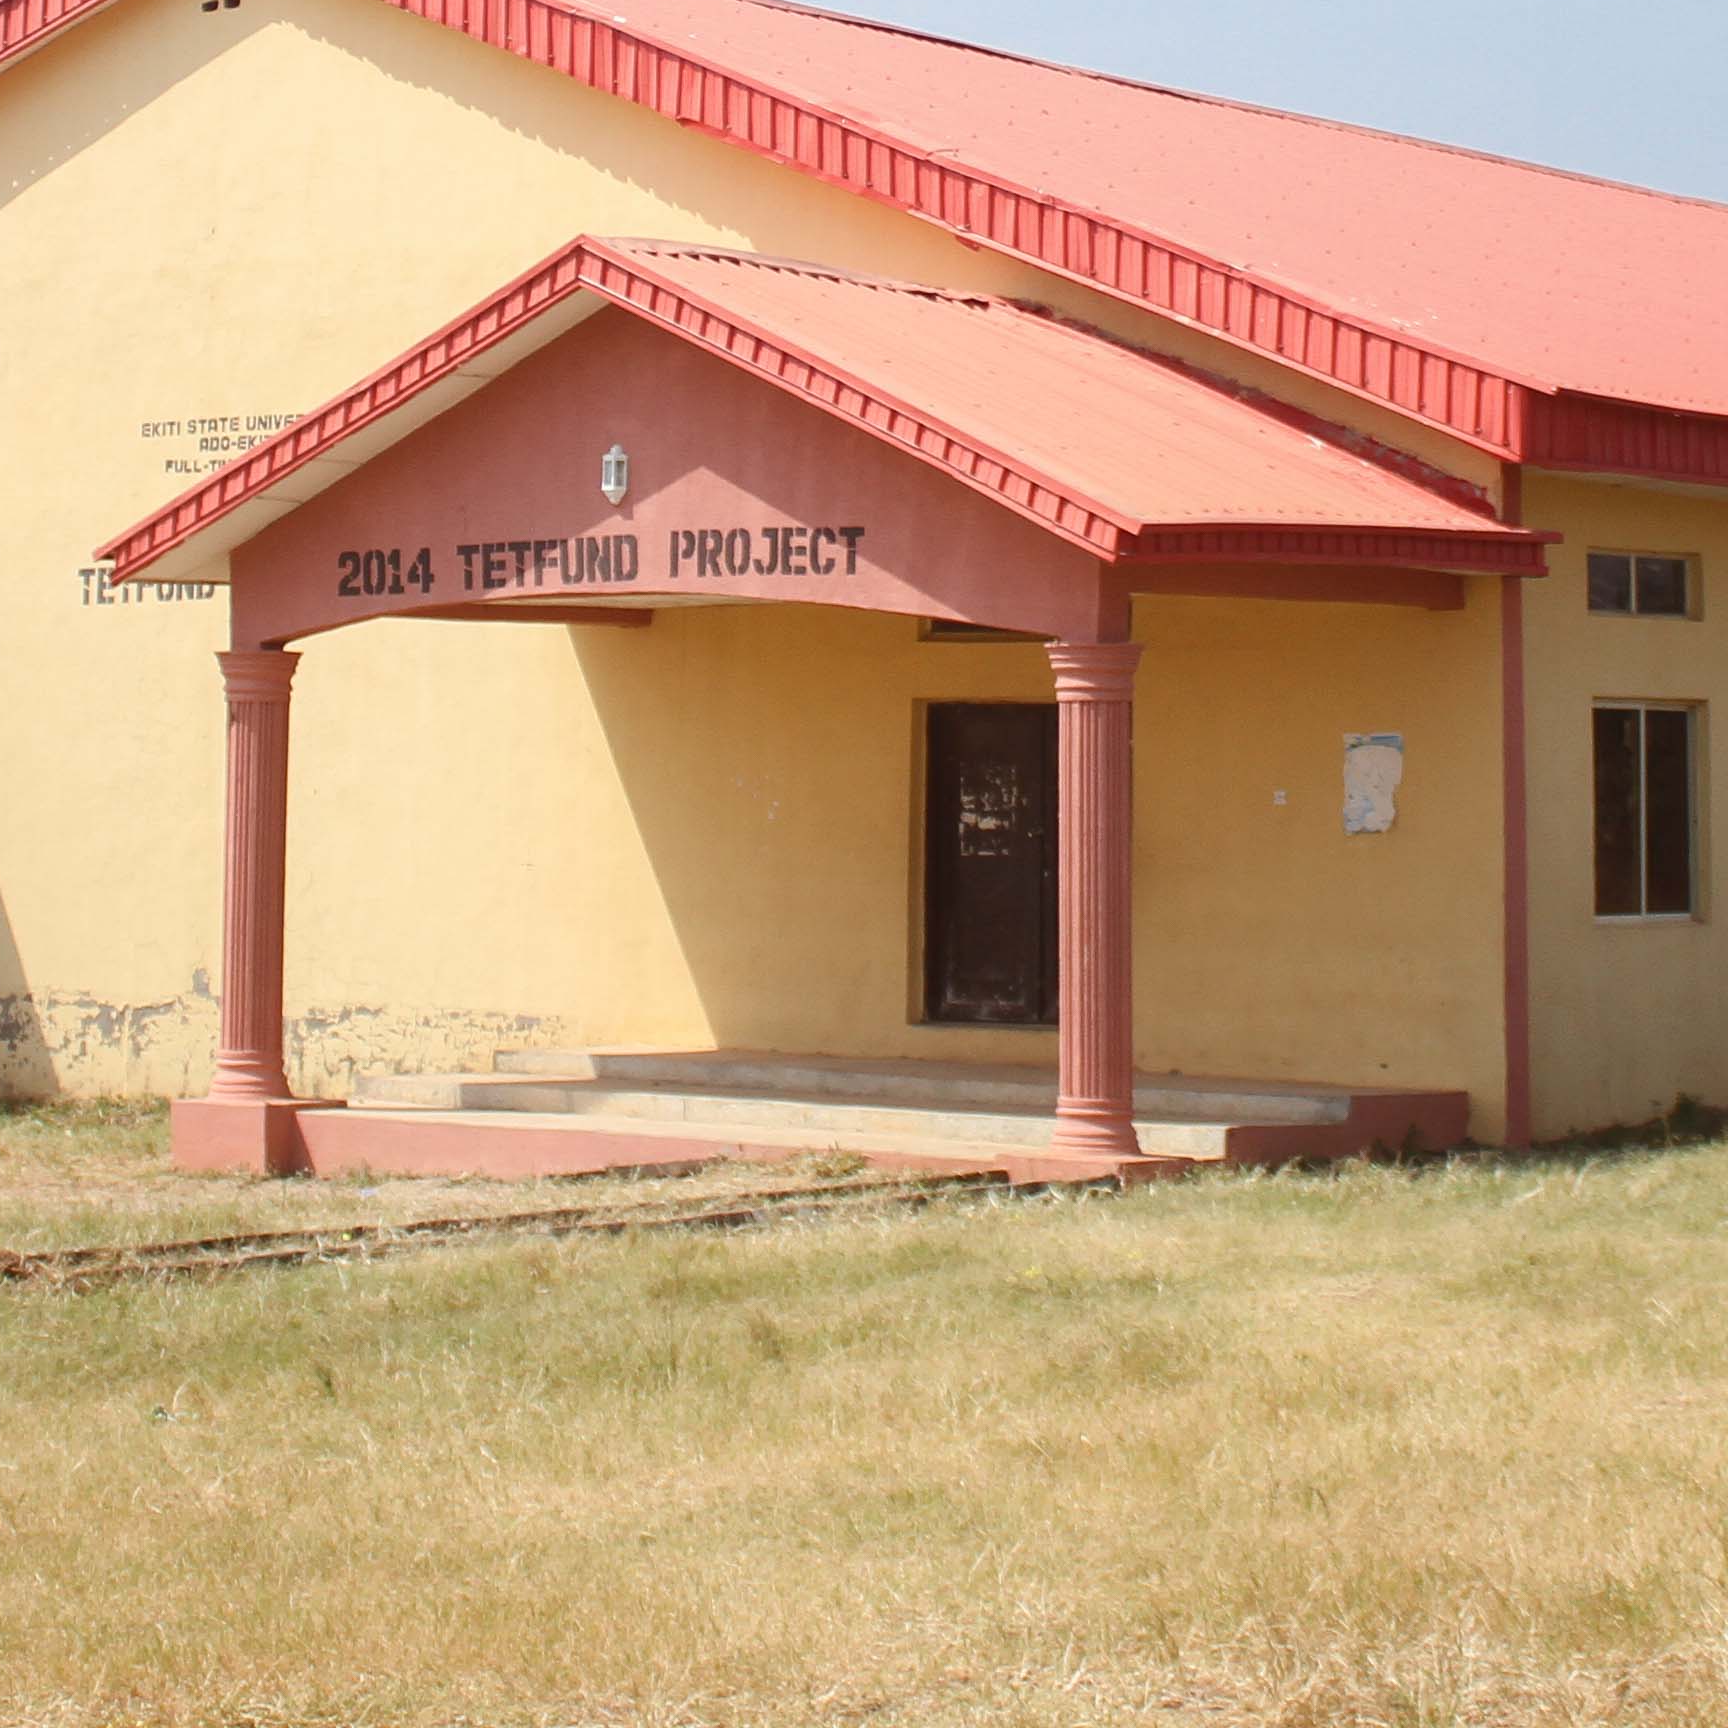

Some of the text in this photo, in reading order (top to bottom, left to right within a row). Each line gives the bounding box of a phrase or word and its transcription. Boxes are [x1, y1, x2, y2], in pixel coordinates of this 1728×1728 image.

[141, 414, 305, 437] EKITI STATE UNIVE
[338, 526, 866, 596] 2014 TETFUND PROJECT
